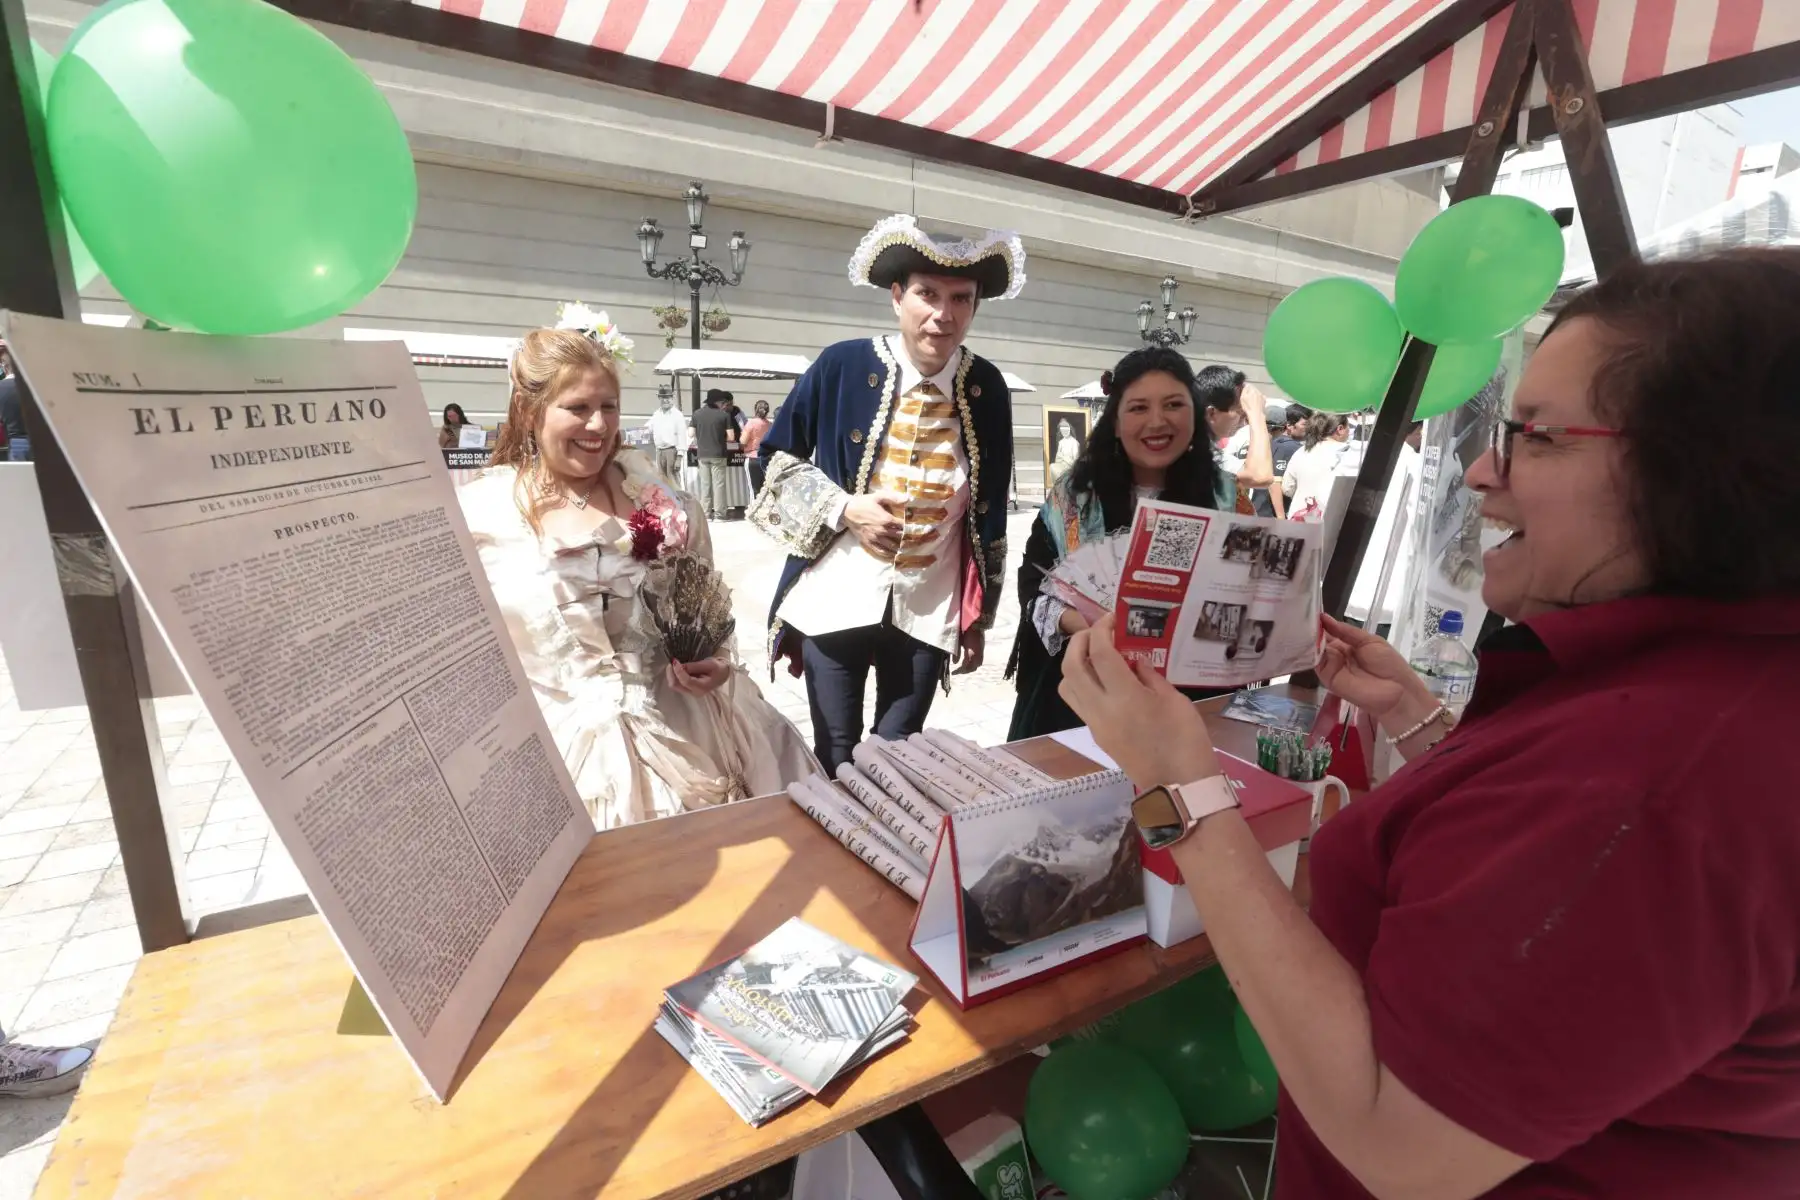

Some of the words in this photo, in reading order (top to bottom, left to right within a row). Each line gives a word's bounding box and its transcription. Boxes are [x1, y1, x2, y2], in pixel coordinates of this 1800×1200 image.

[72, 371, 121, 388] NUM.
[128, 406, 194, 436] EL
[210, 398, 387, 432] PERUANO
[200, 500, 226, 514] DEL
[273, 511, 360, 541] PROSPECTO.
[849, 779, 906, 834] PERUANO
[806, 805, 880, 865] PERUANO
[908, 832, 930, 854] EL
[884, 862, 912, 886] EL
